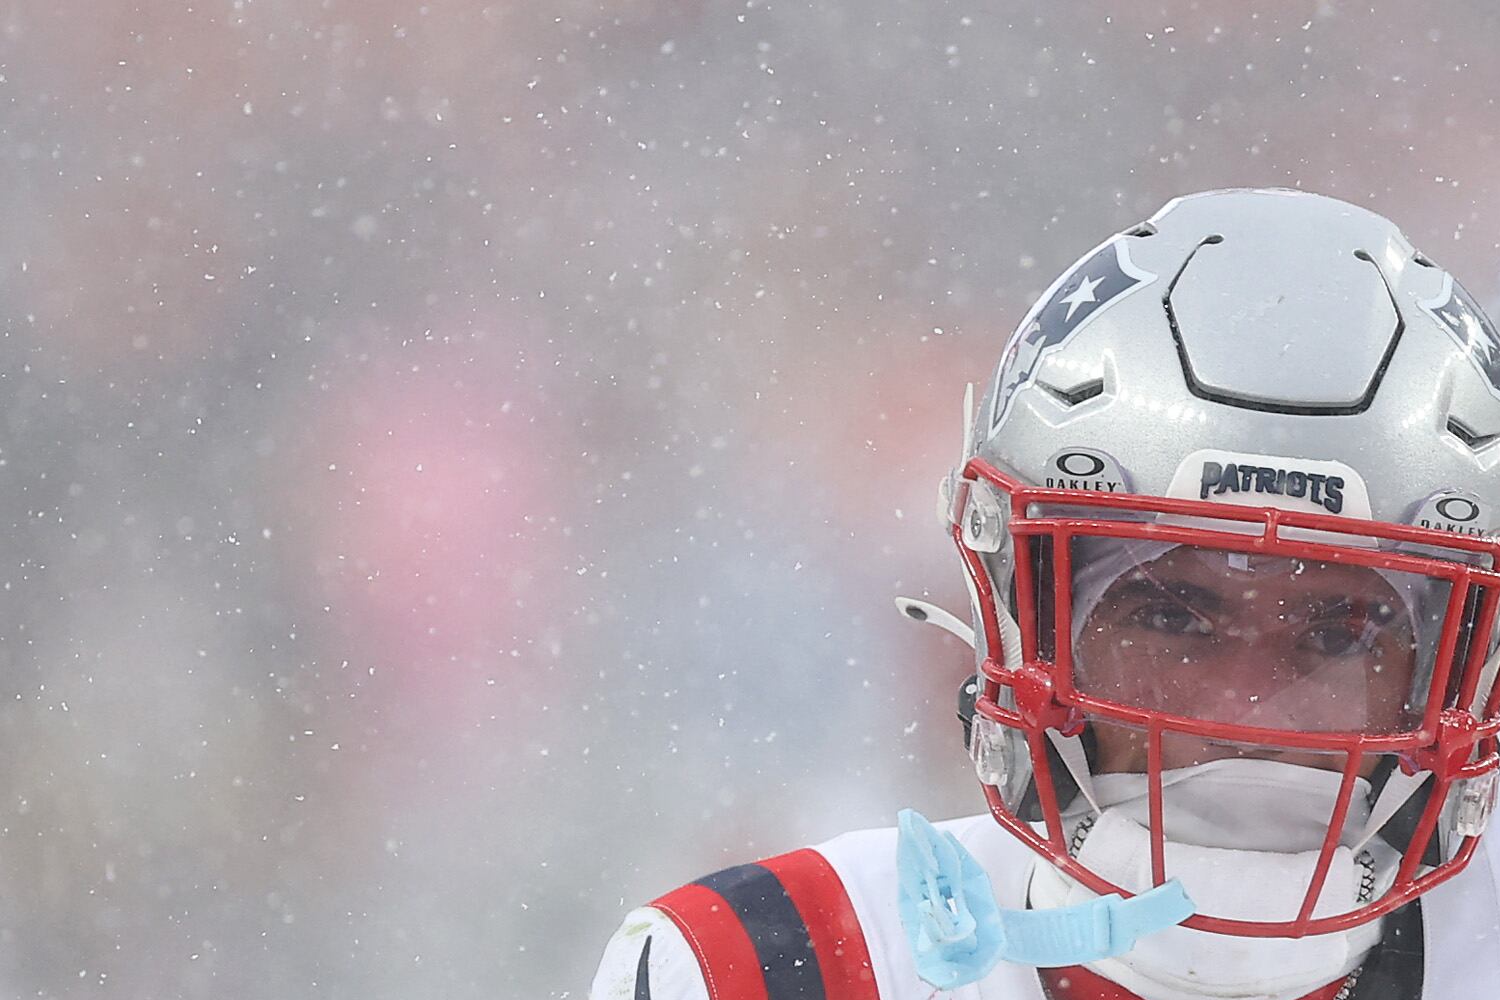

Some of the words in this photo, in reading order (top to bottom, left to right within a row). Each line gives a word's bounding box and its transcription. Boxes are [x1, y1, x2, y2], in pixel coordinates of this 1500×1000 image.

[1046, 477, 1117, 492] OAKLEY
[1200, 461, 1345, 514] PATRIOTS
[1421, 519, 1484, 537] OAKLEY
